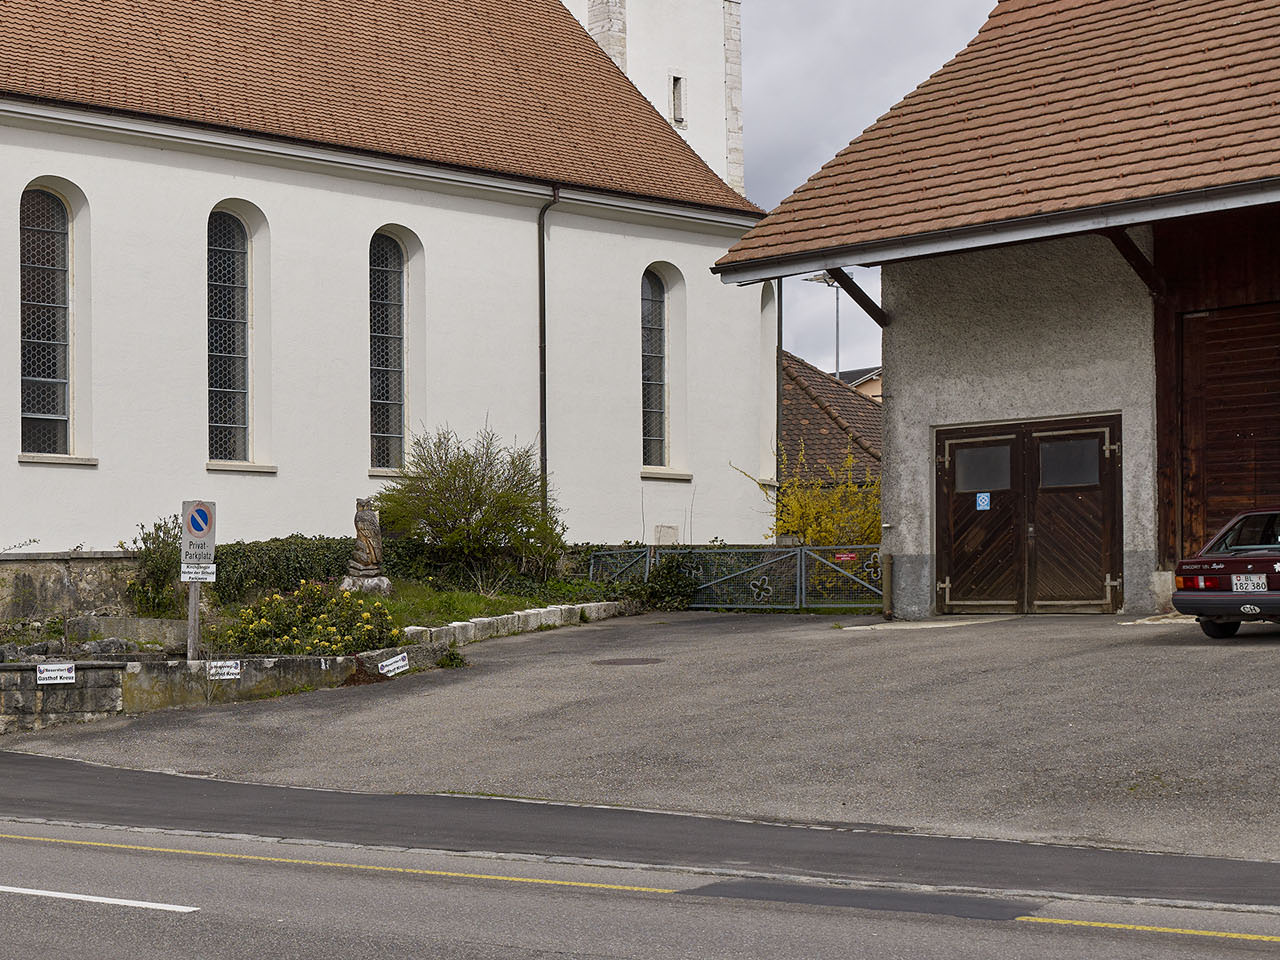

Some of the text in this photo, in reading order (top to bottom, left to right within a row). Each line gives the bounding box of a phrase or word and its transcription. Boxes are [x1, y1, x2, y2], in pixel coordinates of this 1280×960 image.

[189, 541, 209, 550] Privat-
[185, 551, 212, 561] Parkplatz
[1252, 582, 1266, 590] 380
